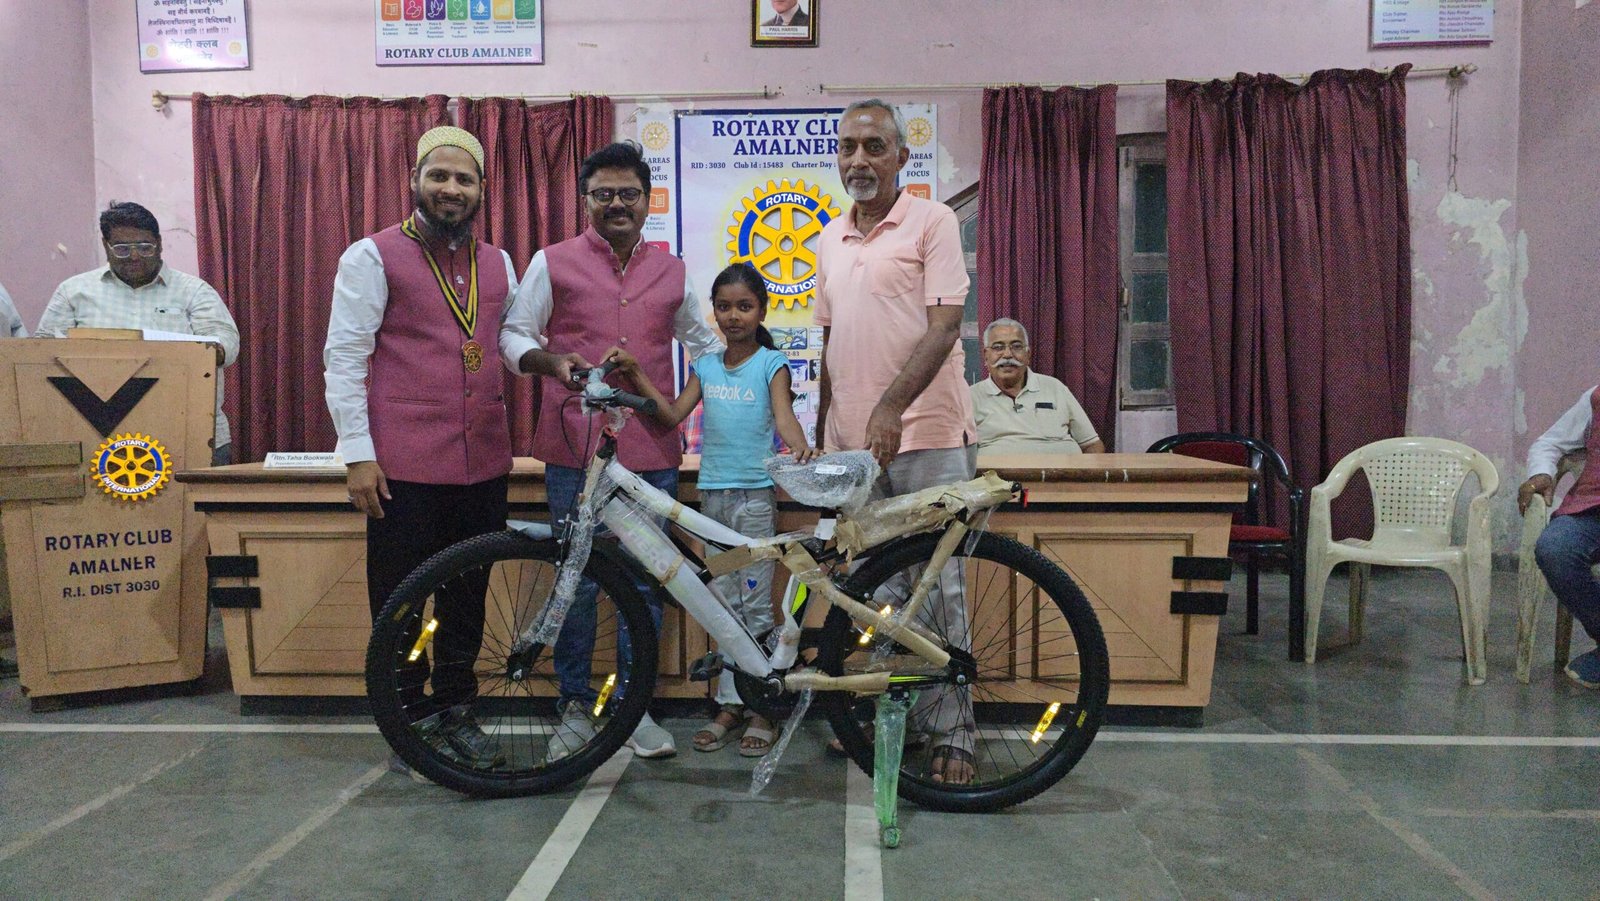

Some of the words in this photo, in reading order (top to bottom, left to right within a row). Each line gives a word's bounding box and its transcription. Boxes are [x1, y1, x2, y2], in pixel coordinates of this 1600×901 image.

[196, 39, 218, 48] क्लब
[385, 48, 434, 58] ROTARY
[437, 47, 469, 58] CLUB
[471, 47, 533, 58] AMALNER
[712, 119, 800, 136] ROTARY
[733, 138, 839, 155] AMALNER
[820, 161, 833, 169] Day
[765, 193, 808, 207] ROTARY
[704, 383, 741, 400] Reebok
[114, 439, 147, 448] ROTARY
[102, 474, 161, 493] INTERNATIONAL
[45, 532, 120, 551] ROTARY
[124, 529, 172, 546] CLUB
[69, 556, 156, 576] AMALNER
[63, 587, 85, 598] R.I.
[91, 583, 121, 596] DIST
[127, 580, 160, 592] 3030
